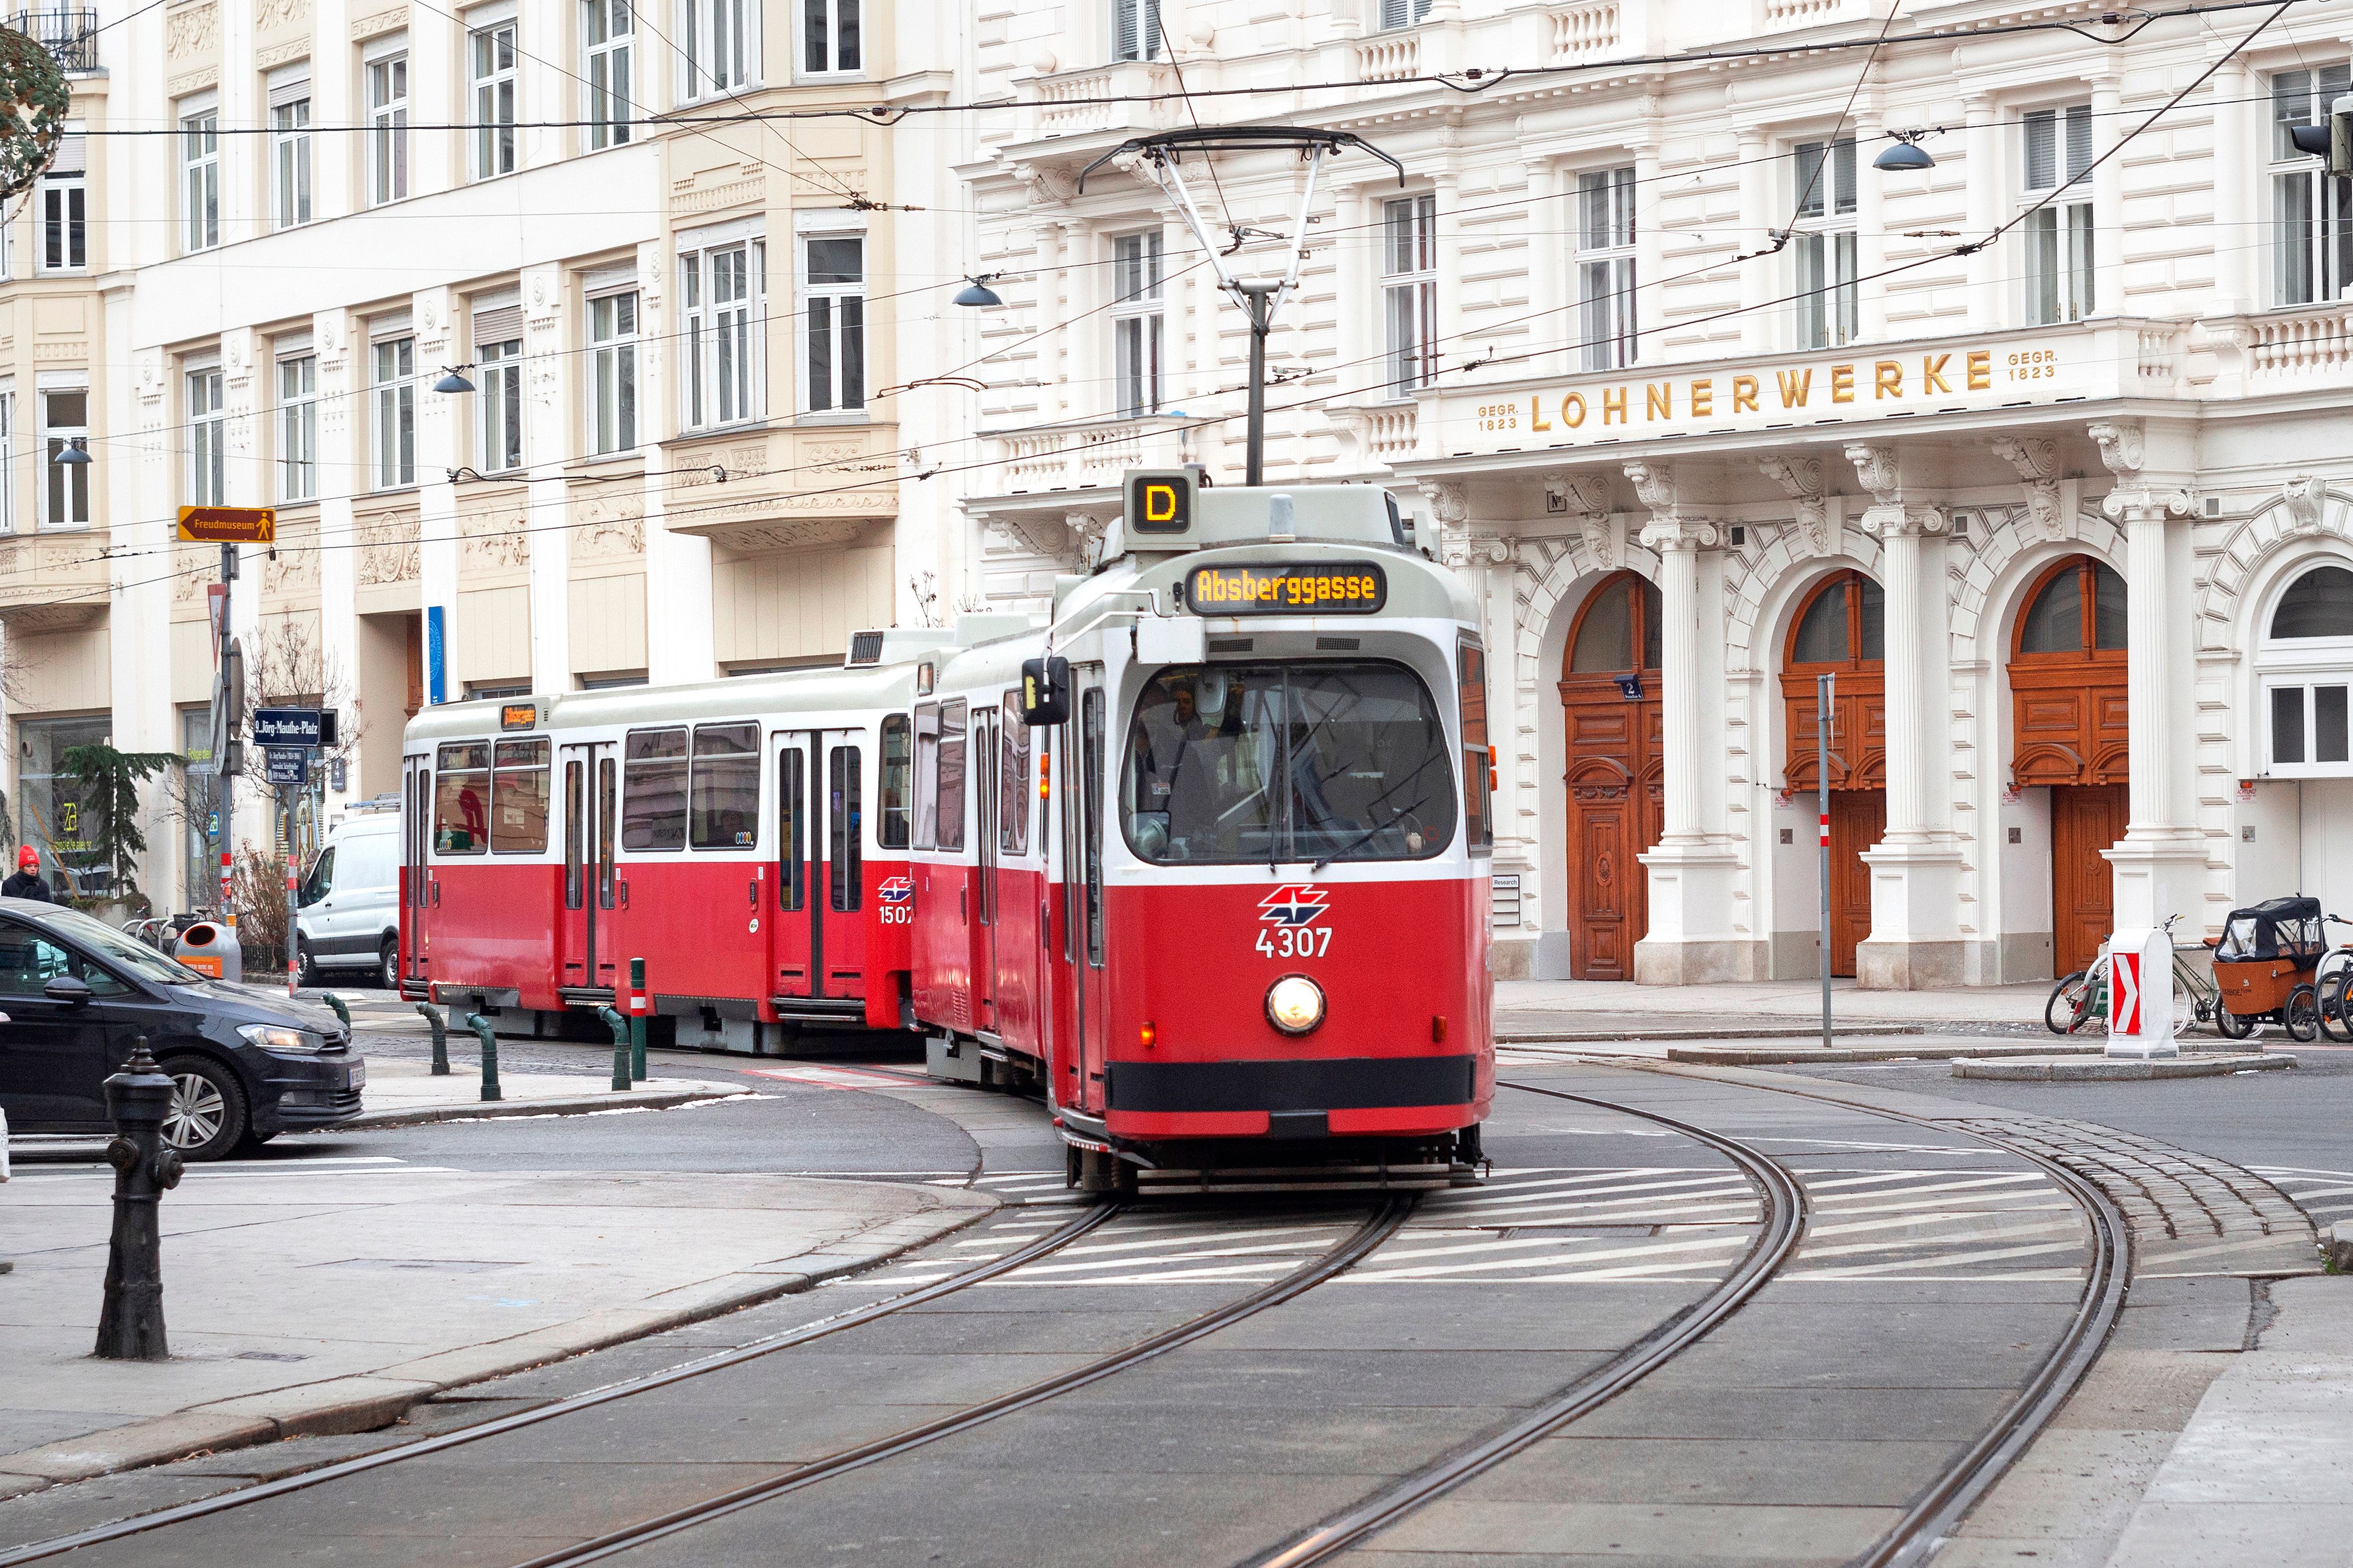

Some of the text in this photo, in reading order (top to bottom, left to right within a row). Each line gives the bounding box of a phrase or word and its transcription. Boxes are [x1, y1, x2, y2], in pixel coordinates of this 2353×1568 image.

[2008, 350, 2058, 366] GEGR.
[2009, 365, 2055, 381] 1823
[1531, 349, 1991, 432] LOHNERWERKE
[1478, 403, 1519, 417] GEGR.
[1479, 418, 1517, 431] 1823
[1146, 485, 1176, 521] D
[195, 519, 255, 530] Freudmuseum
[1197, 569, 1375, 604] Absberggasse
[1627, 683, 1635, 694] 2
[261, 720, 318, 736] Jörg-Mauthe-Platz
[1255, 928, 1332, 959] 4307
